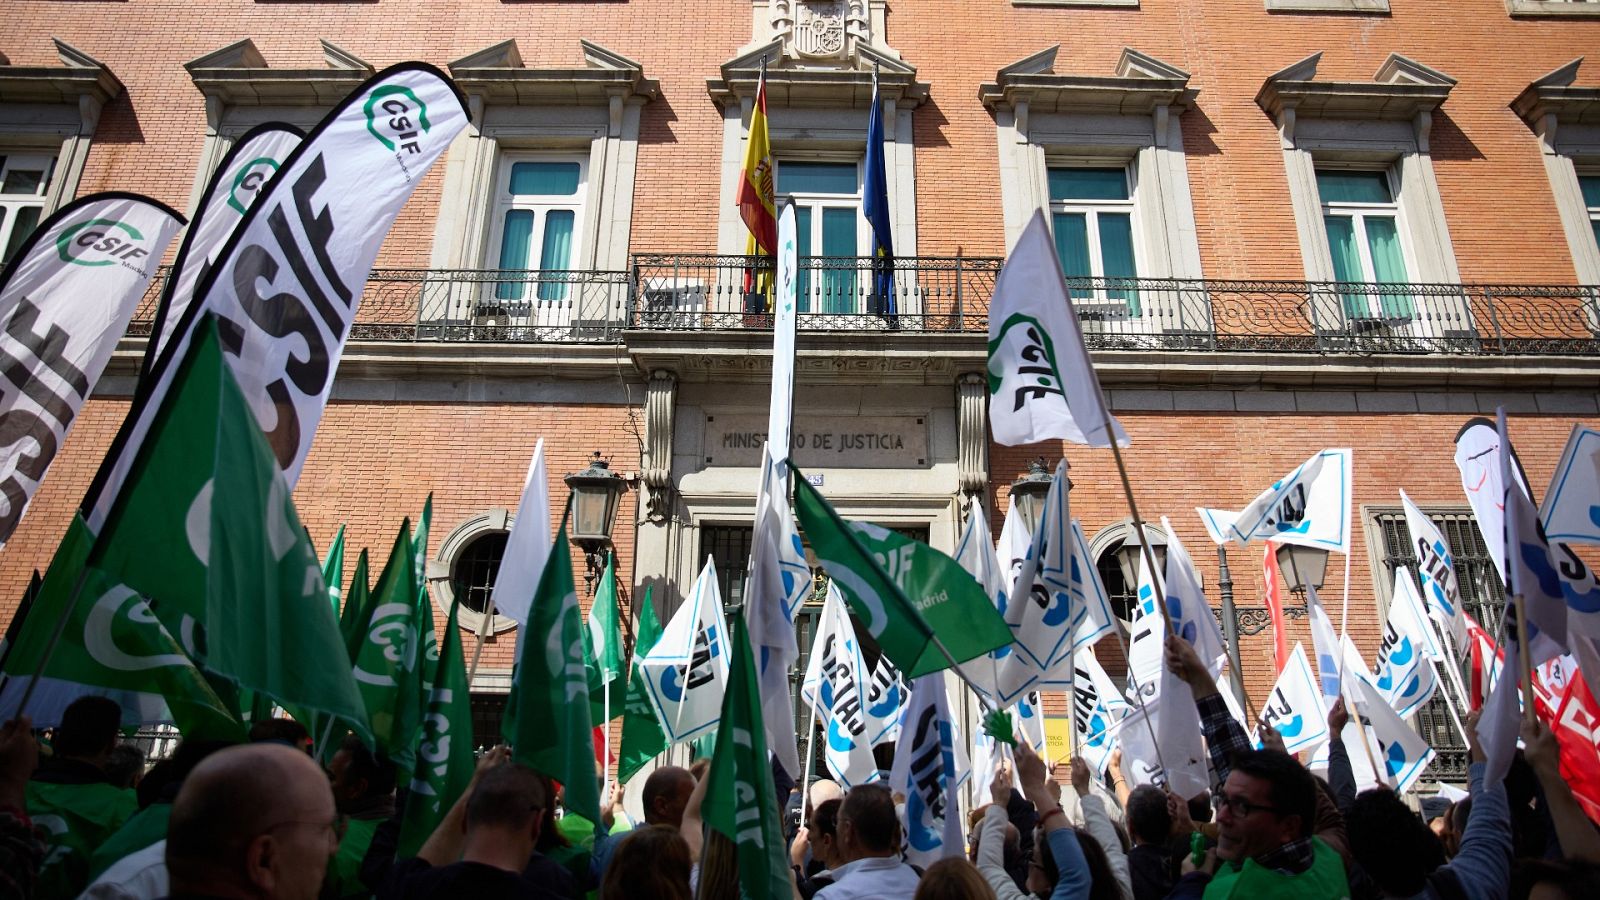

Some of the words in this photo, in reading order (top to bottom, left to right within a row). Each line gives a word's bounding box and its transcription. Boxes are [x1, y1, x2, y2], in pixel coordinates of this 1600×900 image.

[382, 99, 421, 155] CSIF
[77, 231, 148, 263] CSIF
[723, 433, 806, 449] MINISTIO
[812, 434, 833, 449] DE
[838, 433, 904, 452] JUSTICIA
[1418, 537, 1457, 605] STAJ
